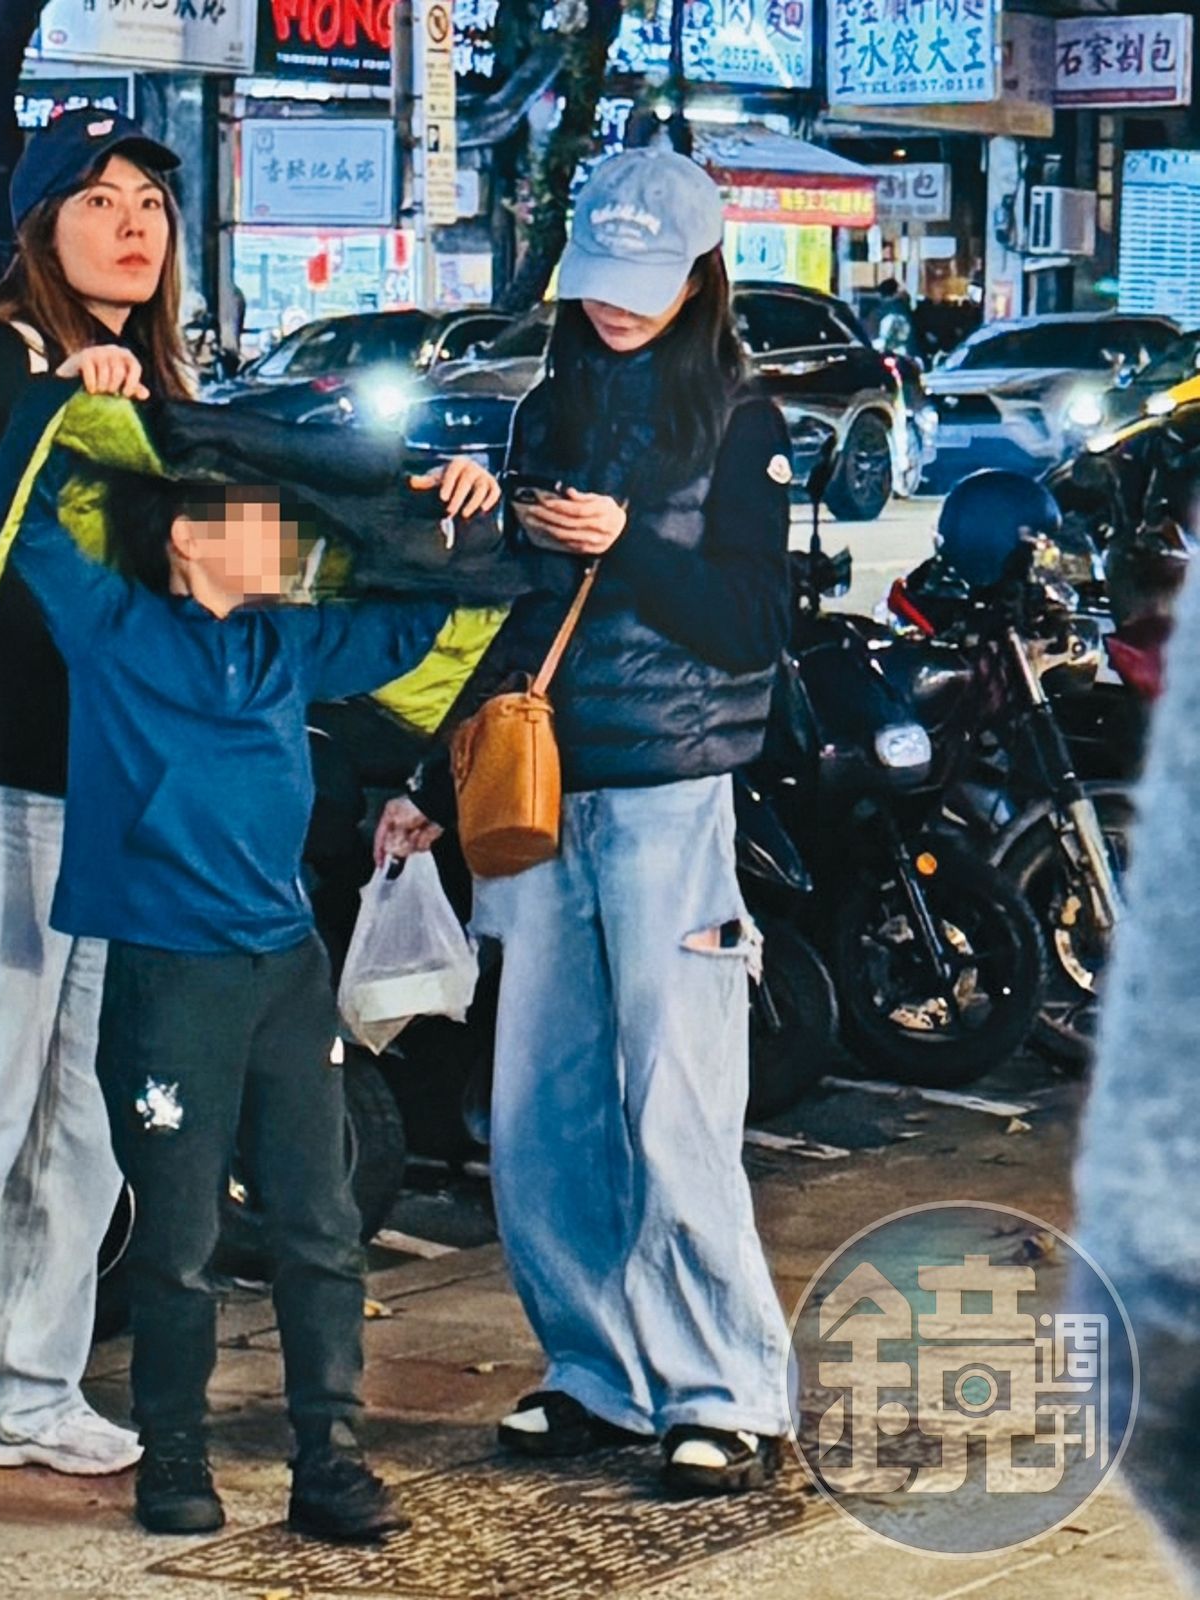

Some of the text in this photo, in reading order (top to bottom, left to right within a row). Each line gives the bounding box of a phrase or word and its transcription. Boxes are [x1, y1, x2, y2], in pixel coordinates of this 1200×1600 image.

[857, 26, 986, 77] 水餃大王
[1057, 31, 1176, 76] 石家割包
